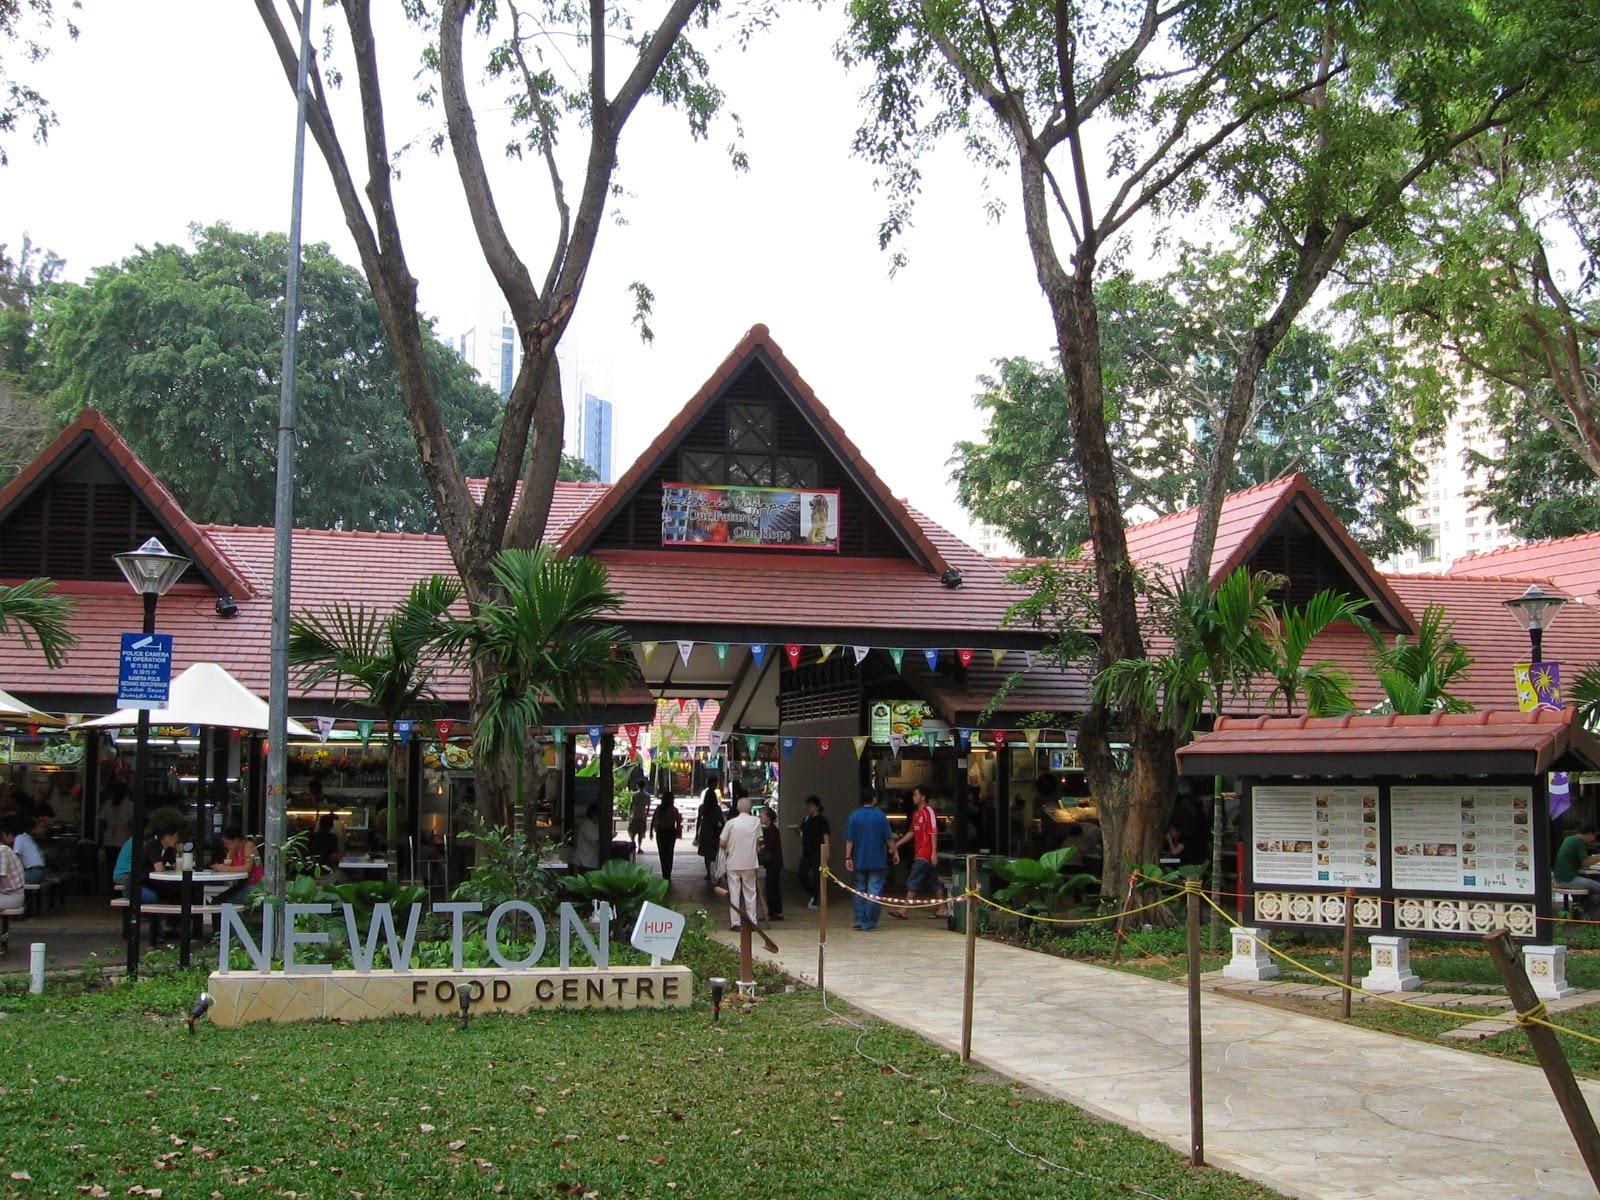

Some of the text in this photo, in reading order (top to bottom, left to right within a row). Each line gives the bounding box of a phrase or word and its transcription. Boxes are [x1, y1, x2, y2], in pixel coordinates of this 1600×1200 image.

[688, 509, 711, 521] Our
[734, 496, 800, 517] Singapore
[734, 526, 792, 543] Our Hope
[645, 922, 673, 933] HUP
[219, 901, 609, 974] NEWTON
[412, 976, 679, 1003] FOOD CENTRE
